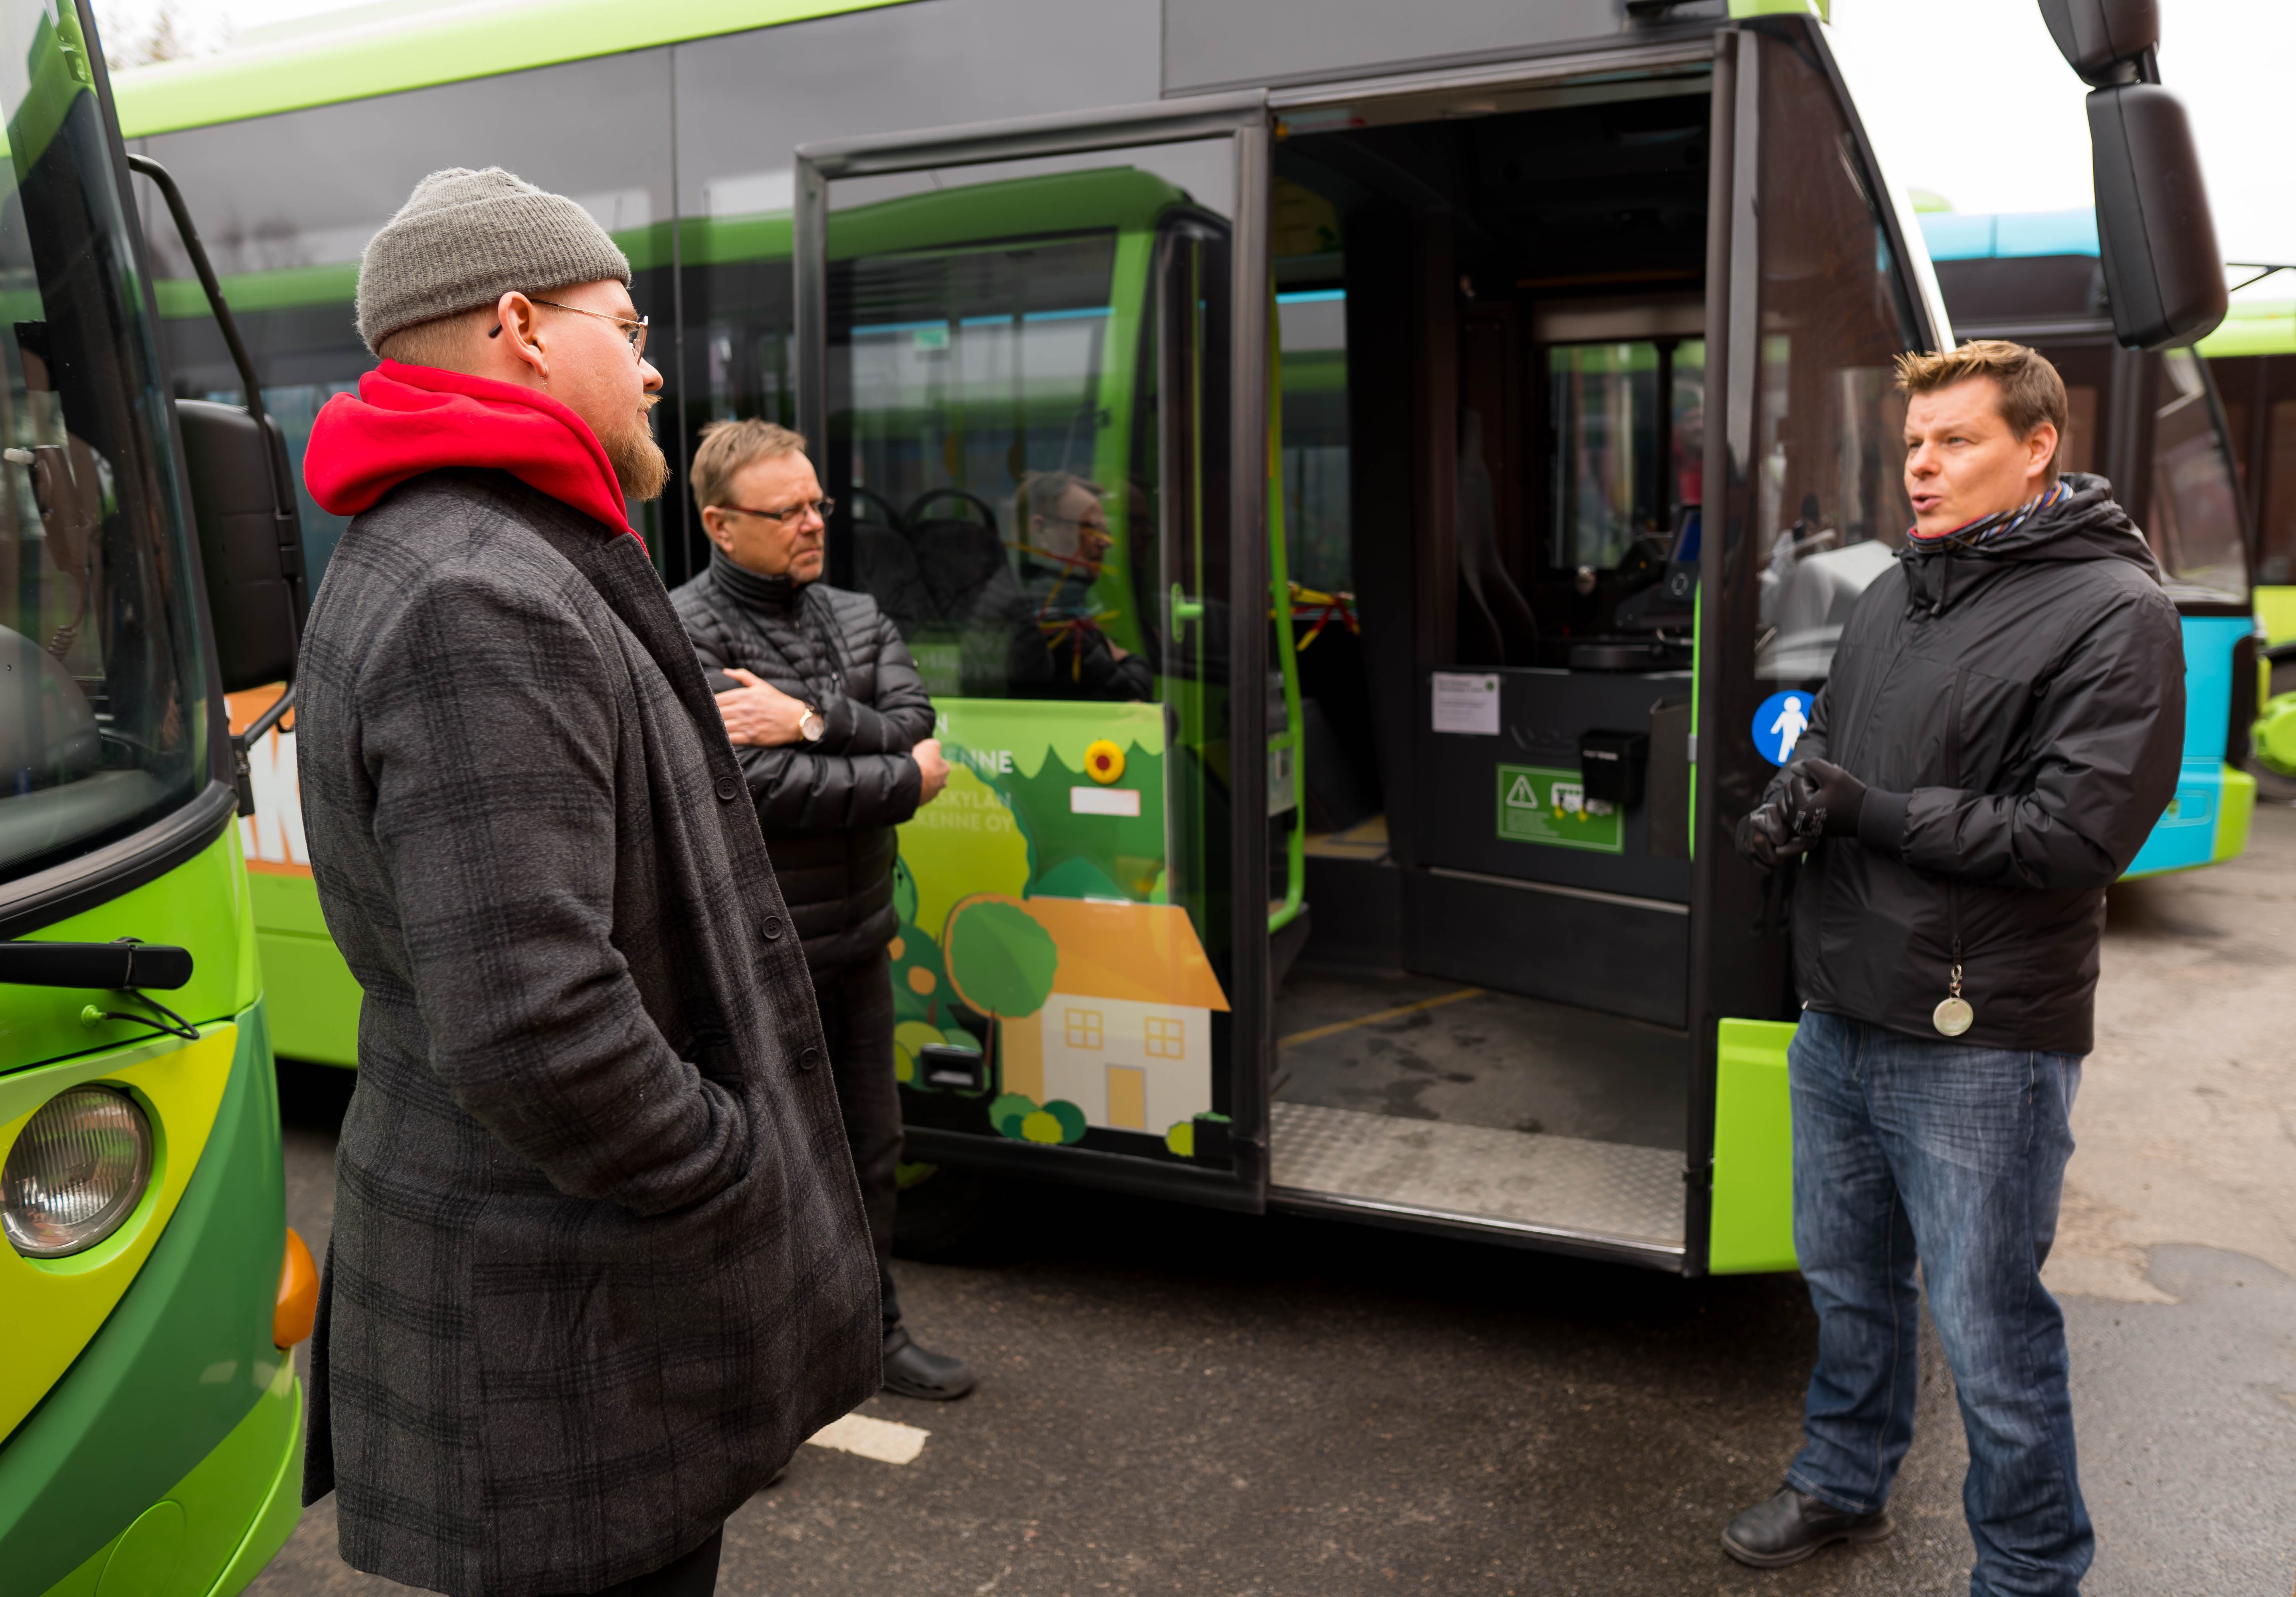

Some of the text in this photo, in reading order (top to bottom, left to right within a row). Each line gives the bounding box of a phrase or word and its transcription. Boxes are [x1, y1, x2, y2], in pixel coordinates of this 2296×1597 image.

[946, 747, 1013, 774] ENNE
[916, 808, 1013, 833] KENNE OY
